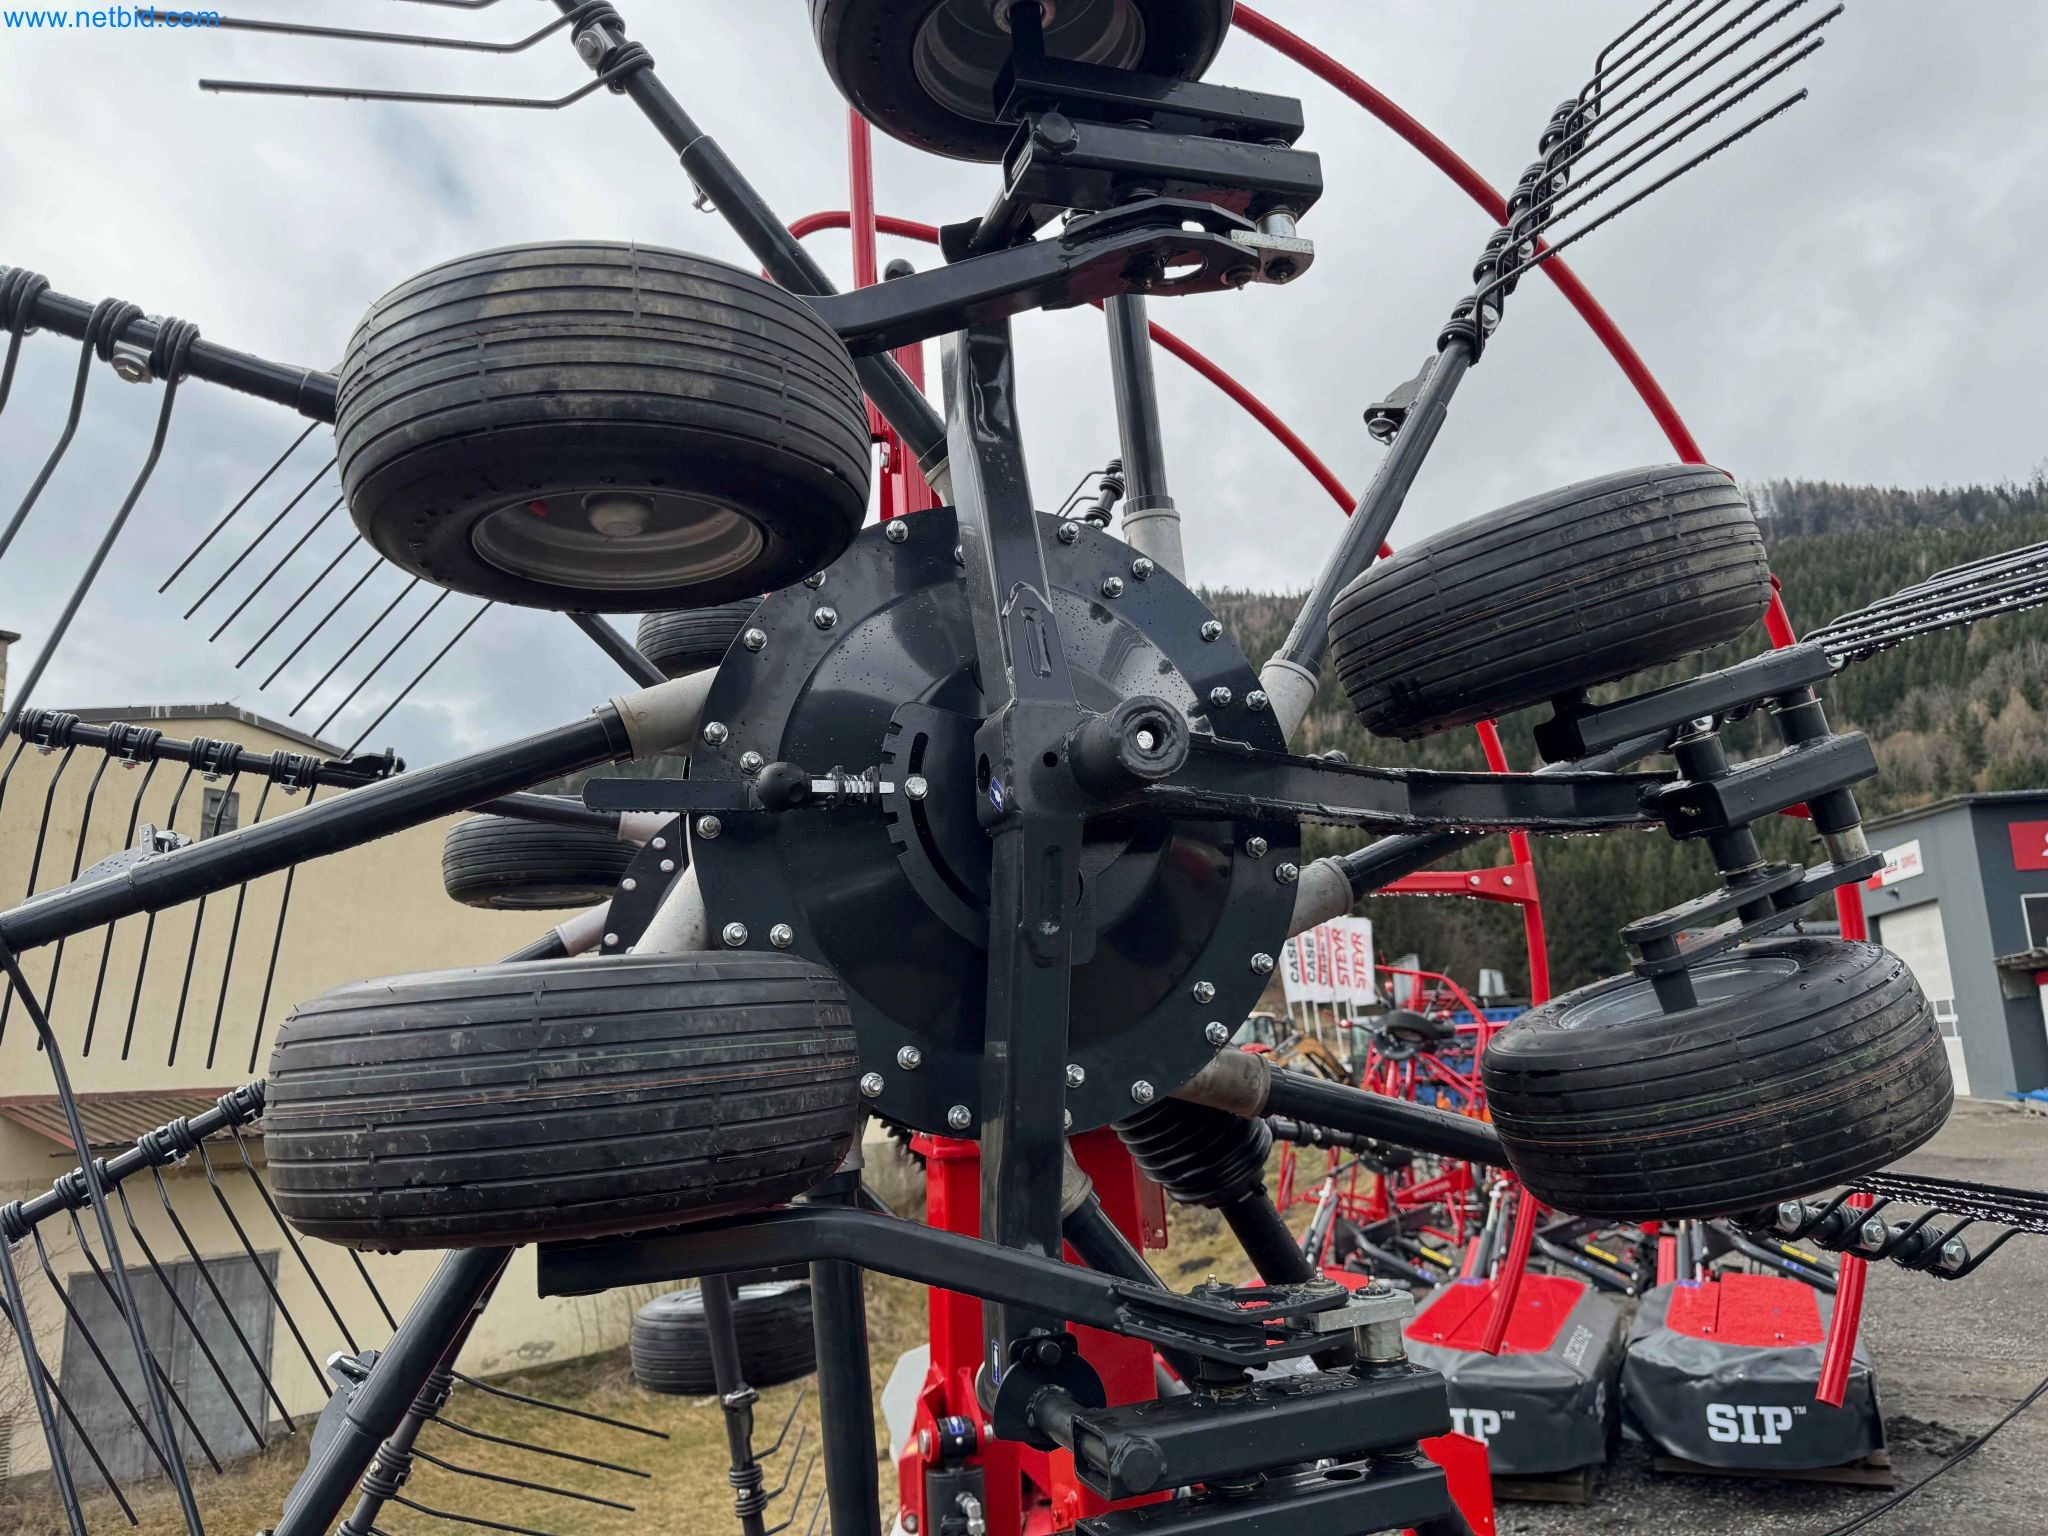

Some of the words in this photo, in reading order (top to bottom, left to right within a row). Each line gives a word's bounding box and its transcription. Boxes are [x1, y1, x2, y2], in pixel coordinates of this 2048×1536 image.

[1305, 937, 1317, 982] CASE
[1332, 928, 1350, 987] STEYR
[1351, 932, 1367, 990] STEYR
